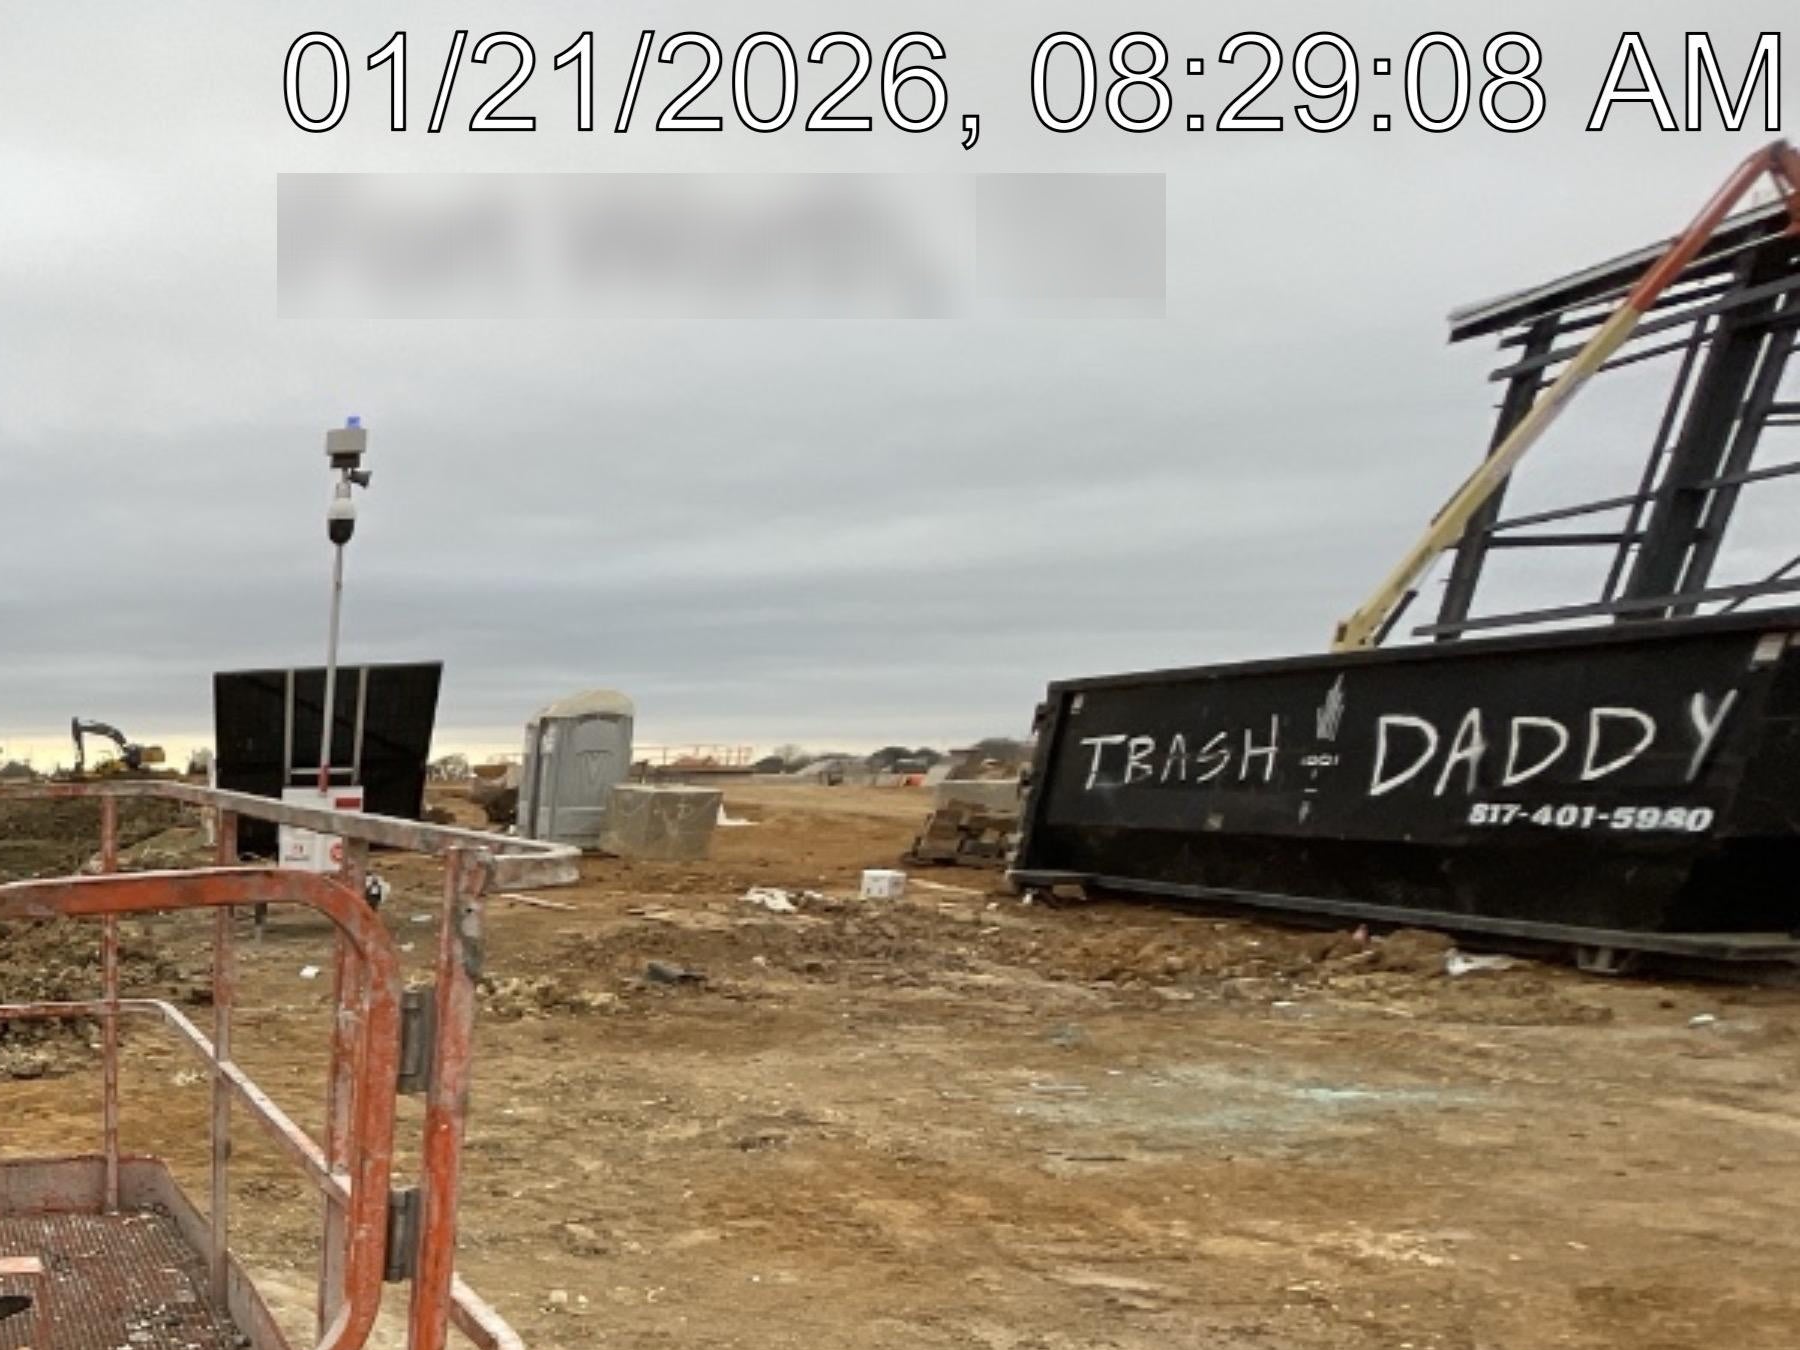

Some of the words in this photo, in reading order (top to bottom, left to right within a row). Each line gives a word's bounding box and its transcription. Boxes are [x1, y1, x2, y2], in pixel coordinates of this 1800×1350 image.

[1079, 713, 1279, 790] TRASH
[1370, 689, 1738, 796] DADDY
[1468, 803, 1714, 832] 817-401-5980
